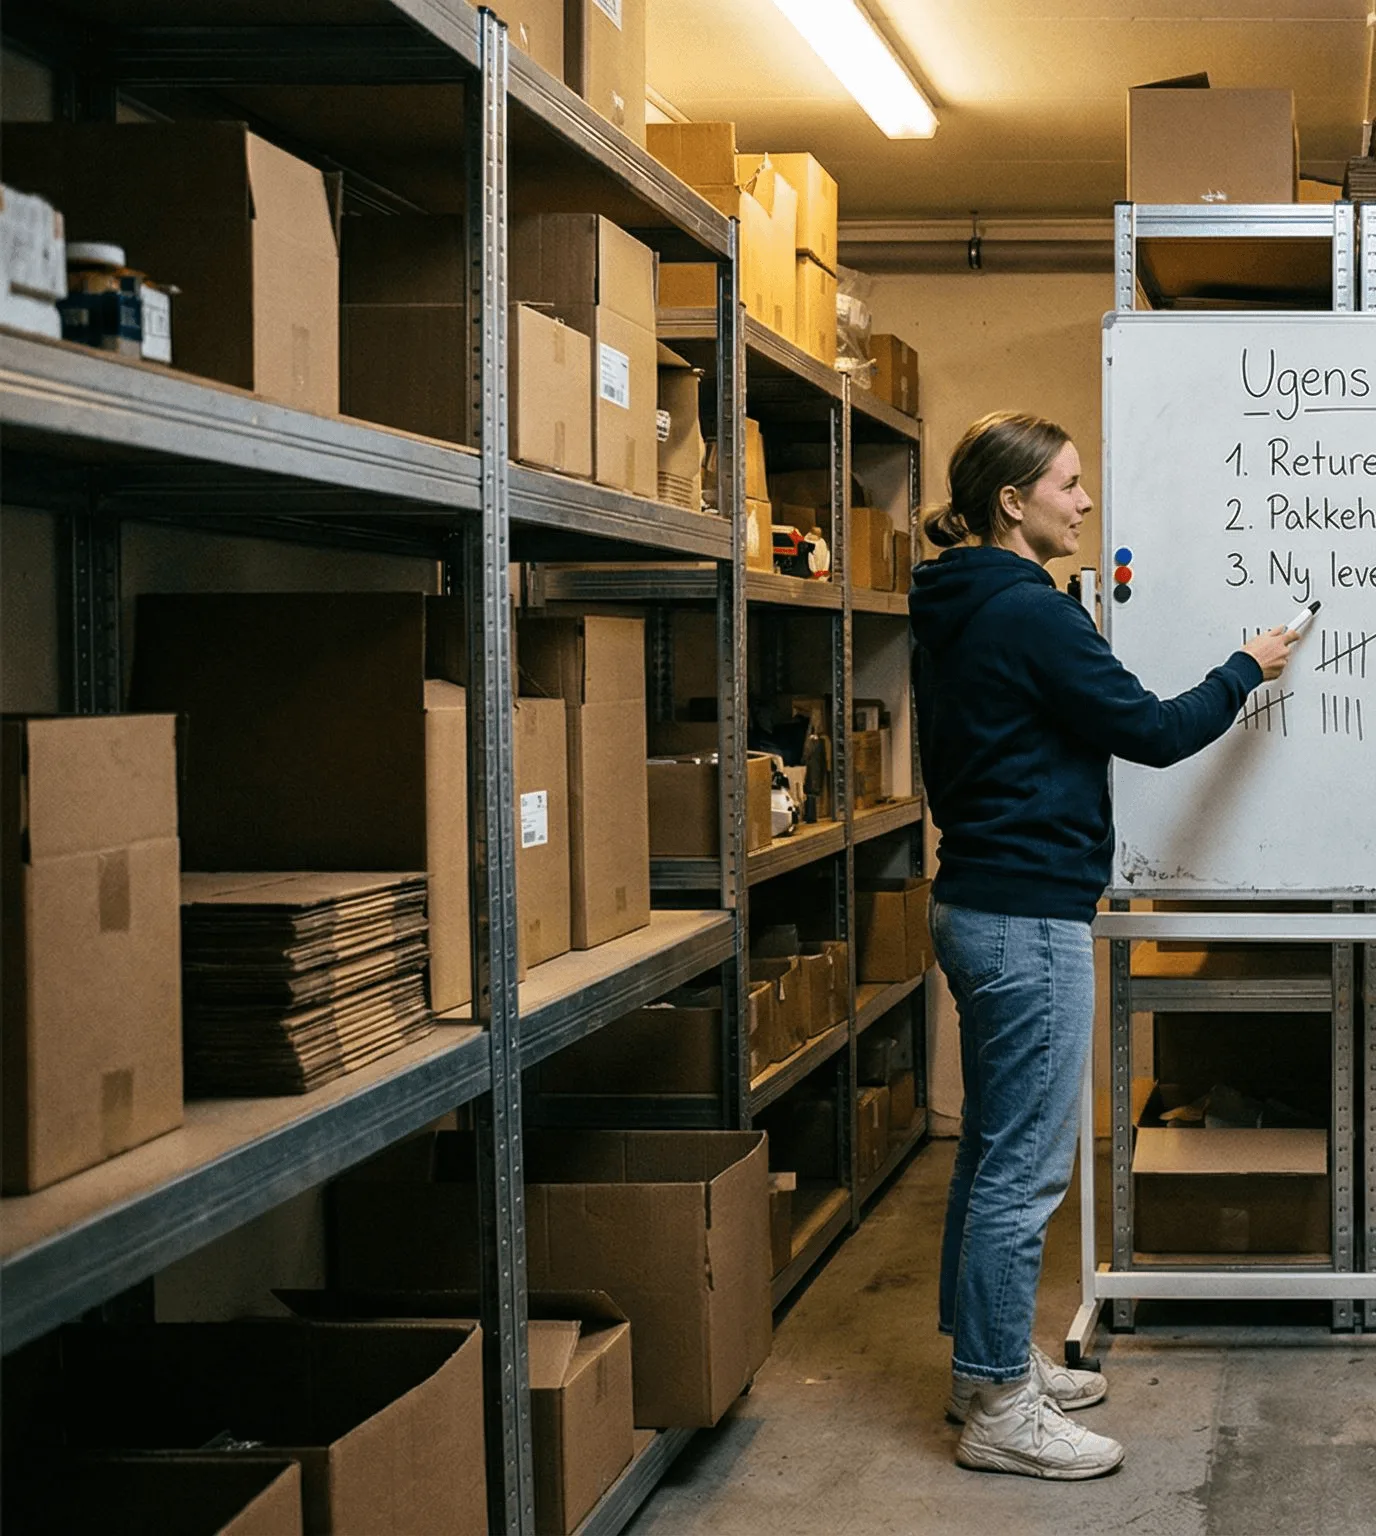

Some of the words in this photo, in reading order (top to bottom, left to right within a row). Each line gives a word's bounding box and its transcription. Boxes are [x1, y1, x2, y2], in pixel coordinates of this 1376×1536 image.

[1242, 348, 1370, 421] Ugens
[1225, 442, 1248, 477] 1.
[1225, 498, 1253, 531] 2.
[1225, 552, 1254, 587] 3.
[1269, 550, 1311, 604] Ny
